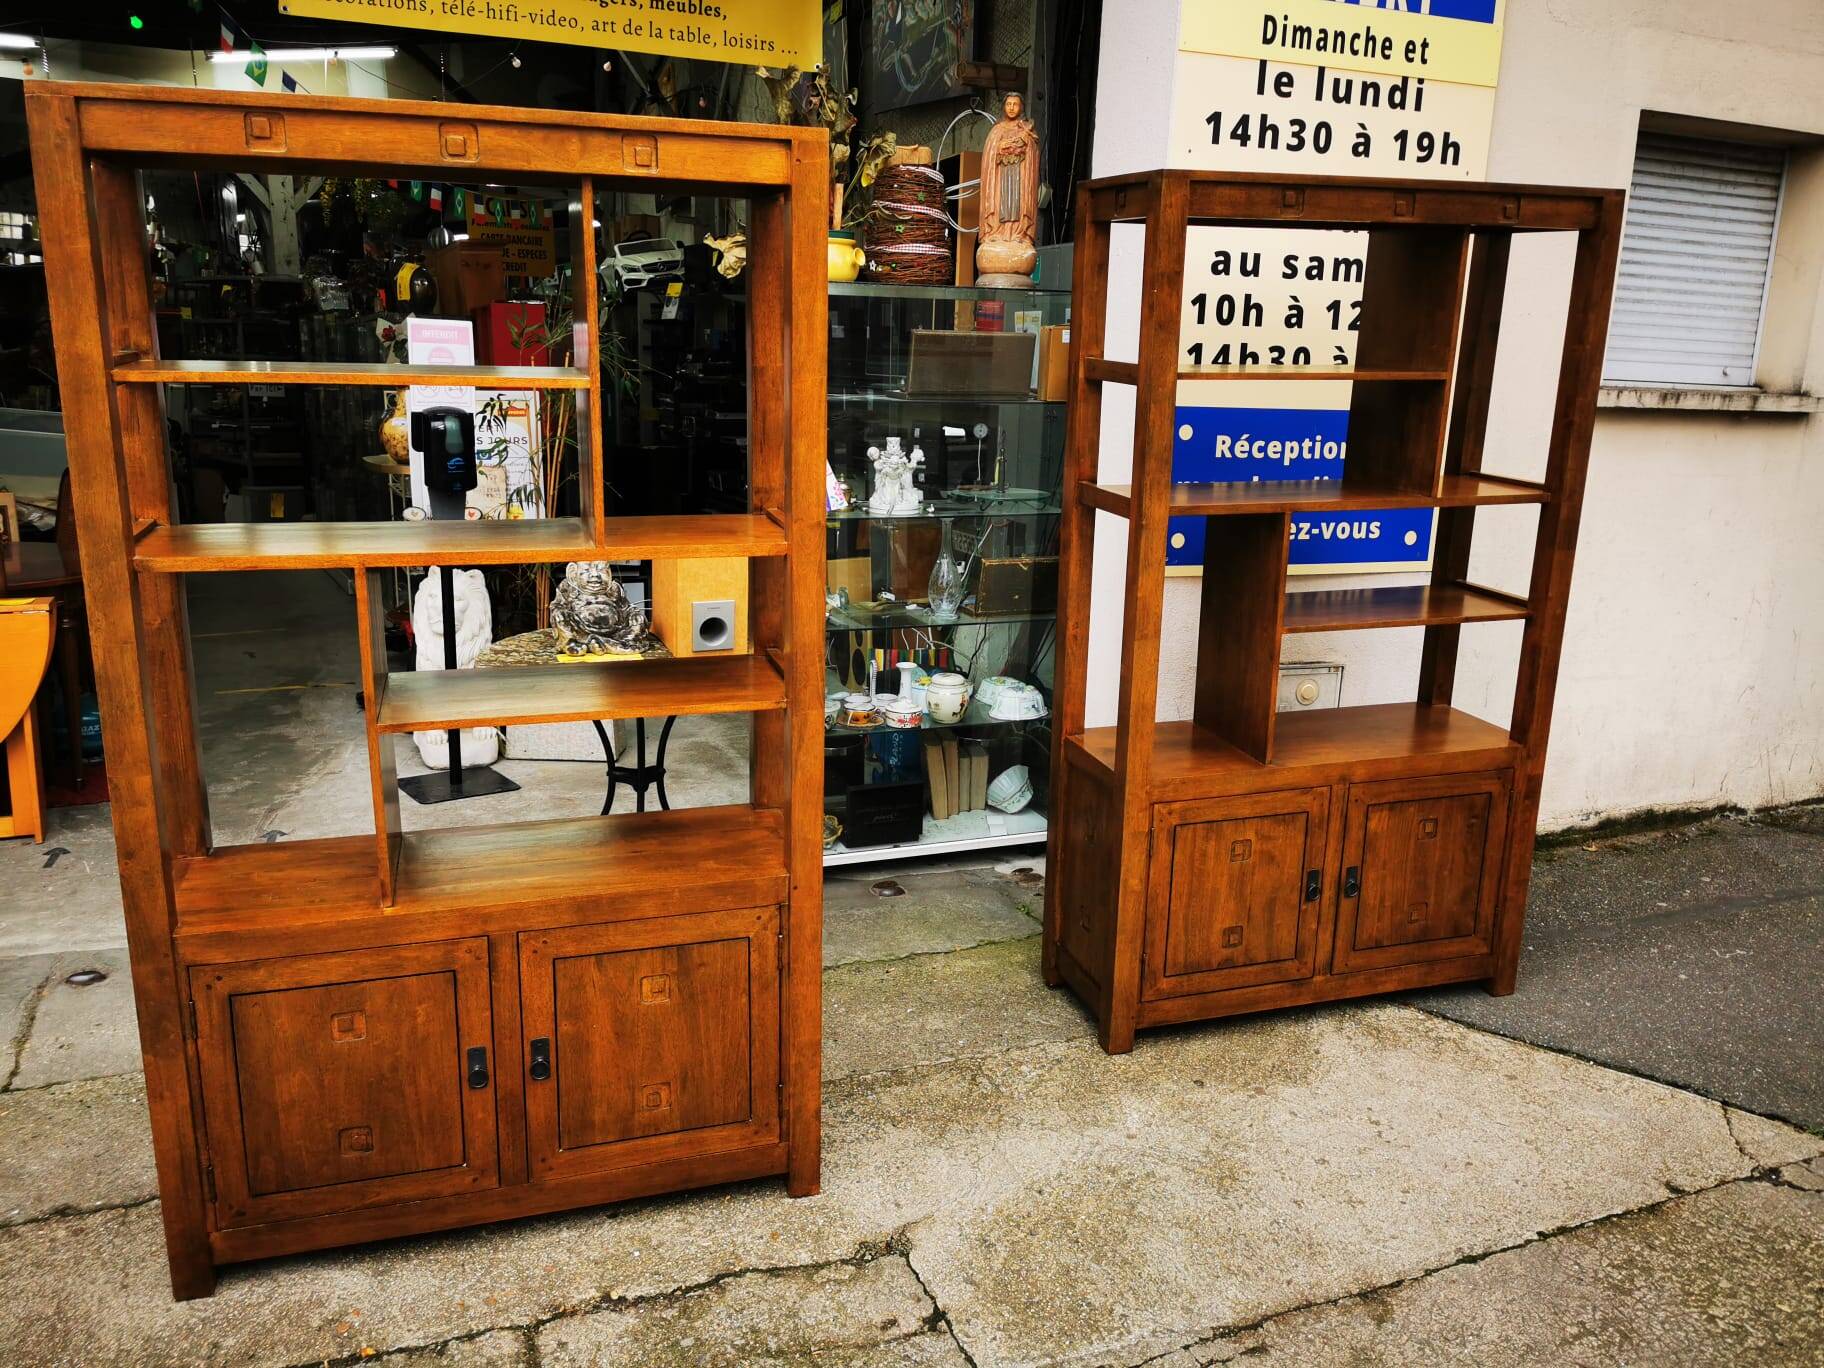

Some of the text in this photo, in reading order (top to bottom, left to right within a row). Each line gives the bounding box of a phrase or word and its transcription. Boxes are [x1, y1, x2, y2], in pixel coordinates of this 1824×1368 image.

[441, 0, 585, 32] télé-hifi-video,
[591, 18, 617, 34] art
[622, 18, 643, 37] de
[649, 21, 663, 40] la
[670, 26, 718, 48] table,
[723, 30, 775, 53] loisirs
[649, 0, 727, 21] meubles,
[1262, 14, 1430, 65] Dimanche et
[1256, 59, 1425, 112] le lundi
[1205, 111, 1461, 166] 14h30 à 19h
[1210, 250, 1363, 283] au sam
[1191, 293, 1264, 327] 10h
[1284, 295, 1304, 329] à
[1187, 343, 1311, 365] 14h30
